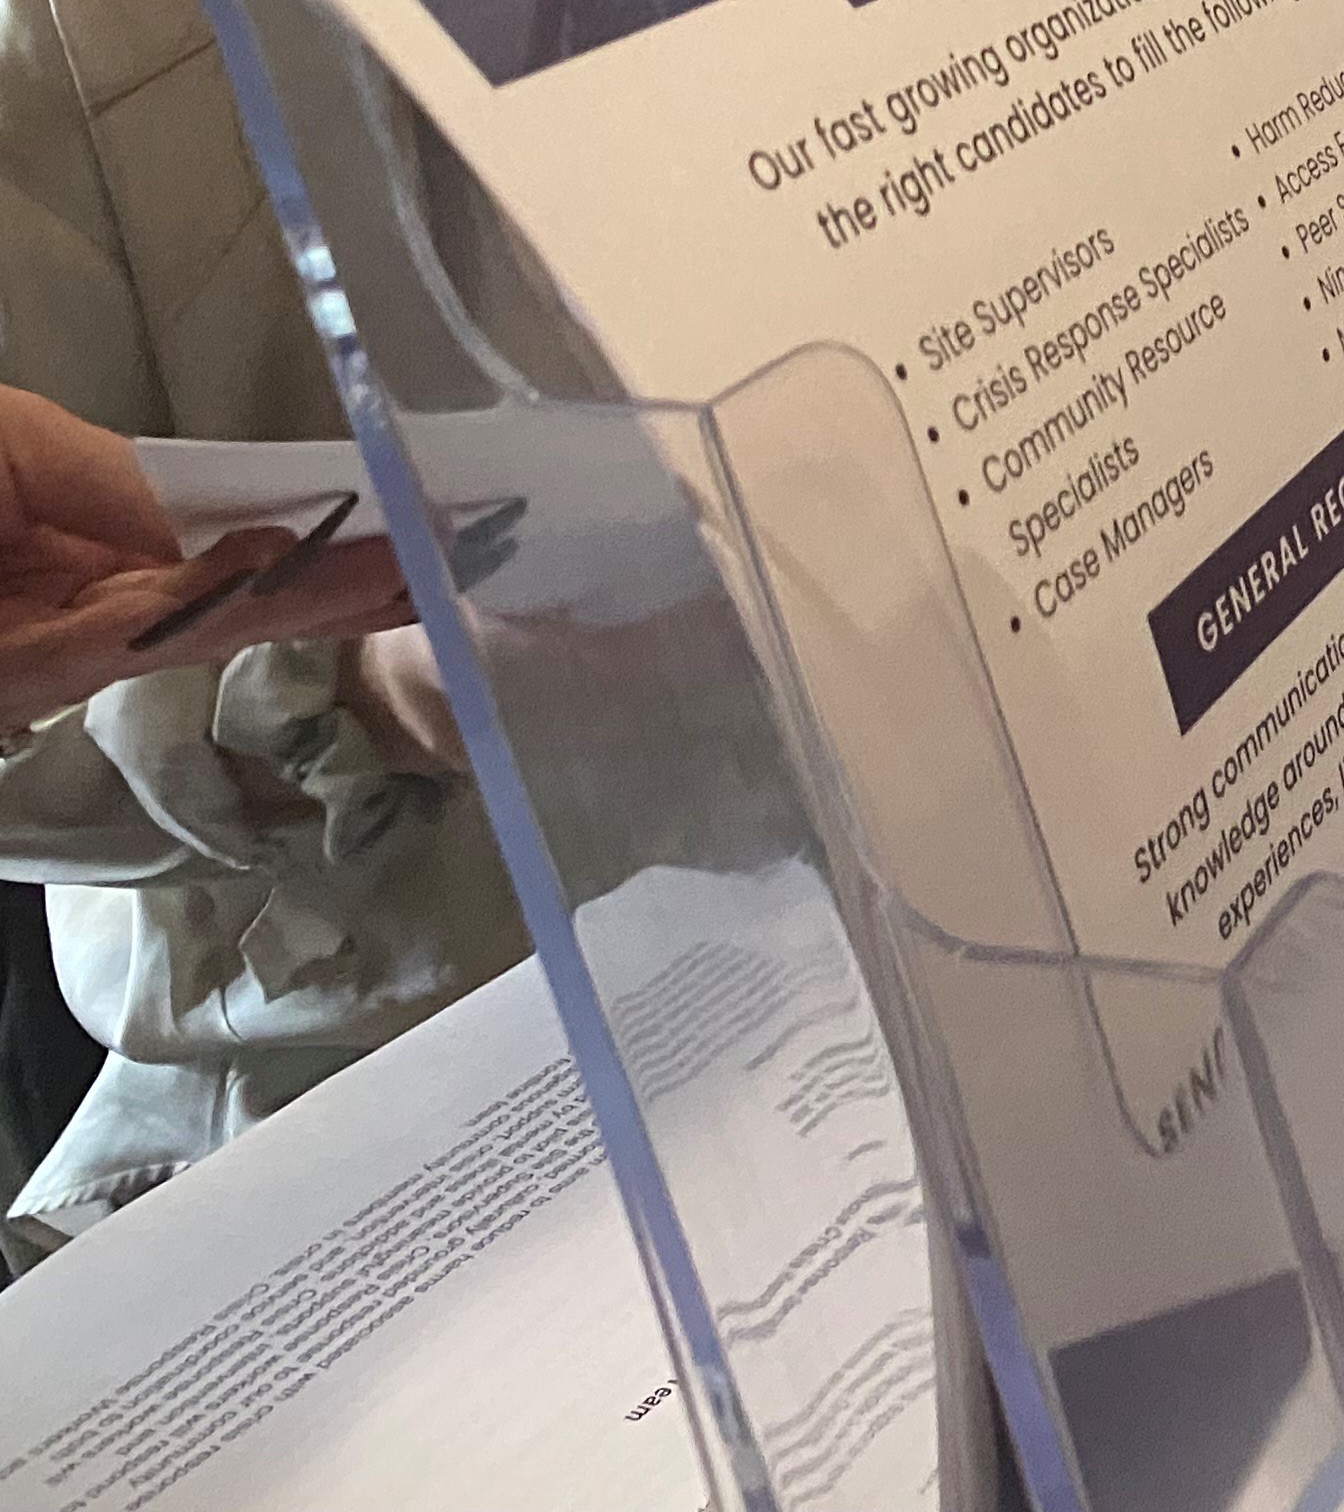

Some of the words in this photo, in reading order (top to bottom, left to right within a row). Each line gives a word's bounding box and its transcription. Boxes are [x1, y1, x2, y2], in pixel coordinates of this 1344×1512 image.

[748, 134, 812, 191] Our
[814, 99, 886, 159] fast
[884, 39, 1009, 136] growing
[817, 194, 879, 251] the
[876, 146, 965, 219] right
[956, 74, 1108, 172] candidates
[1103, 55, 1135, 89] to
[1132, 29, 1169, 76] fill
[1164, 9, 1206, 52] the
[1244, 102, 1300, 157] Harm
[1275, 143, 1338, 203] Access
[918, 318, 977, 371] Site
[974, 225, 1116, 336] Supervisors
[1295, 206, 1339, 255] Peer
[952, 363, 1028, 431] Crisis
[1025, 285, 1142, 385] Response
[1138, 207, 1251, 311] Specialists
[981, 368, 1130, 493] Community
[1123, 293, 1227, 386] Resource
[1009, 434, 1141, 557] Specialists
[1033, 551, 1103, 619] Case
[1100, 447, 1215, 562] Managers
[1196, 523, 1309, 652] GENERAL
[1134, 785, 1210, 884] Strong
[1166, 790, 1281, 928] knowledge
[1217, 793, 1341, 941] experiences,
